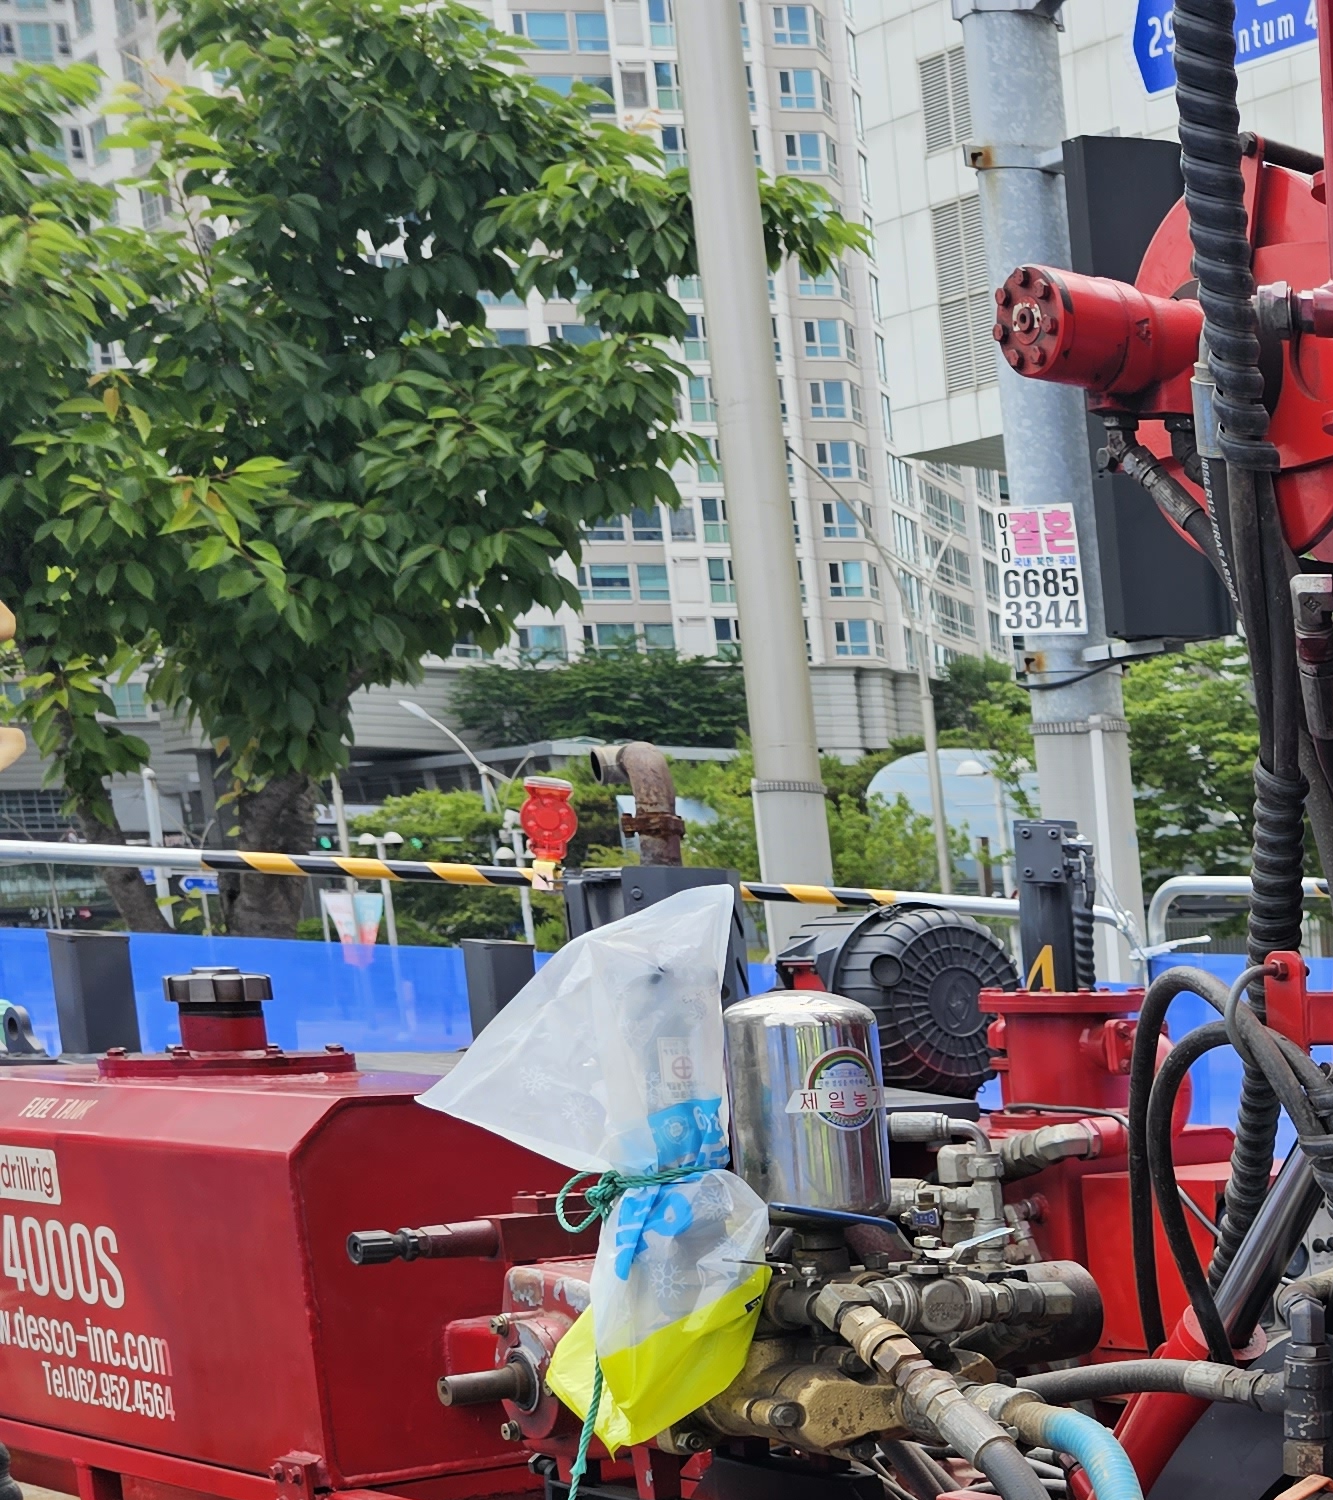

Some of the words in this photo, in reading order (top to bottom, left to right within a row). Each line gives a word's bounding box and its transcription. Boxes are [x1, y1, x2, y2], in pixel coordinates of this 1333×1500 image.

[1237, 13, 1295, 54] ntum
[998, 513, 1011, 563] 010
[1008, 510, 1076, 556] 결혼
[1003, 568, 1079, 598] 6685
[1005, 600, 1082, 629] 3344
[18, 1096, 60, 1119] FUEL
[51, 1098, 99, 1120] TANK
[1, 1154, 54, 1198] drillrig
[2, 1214, 126, 1309] 4000S
[42, 1360, 176, 1422] Tel.062.952.4564
